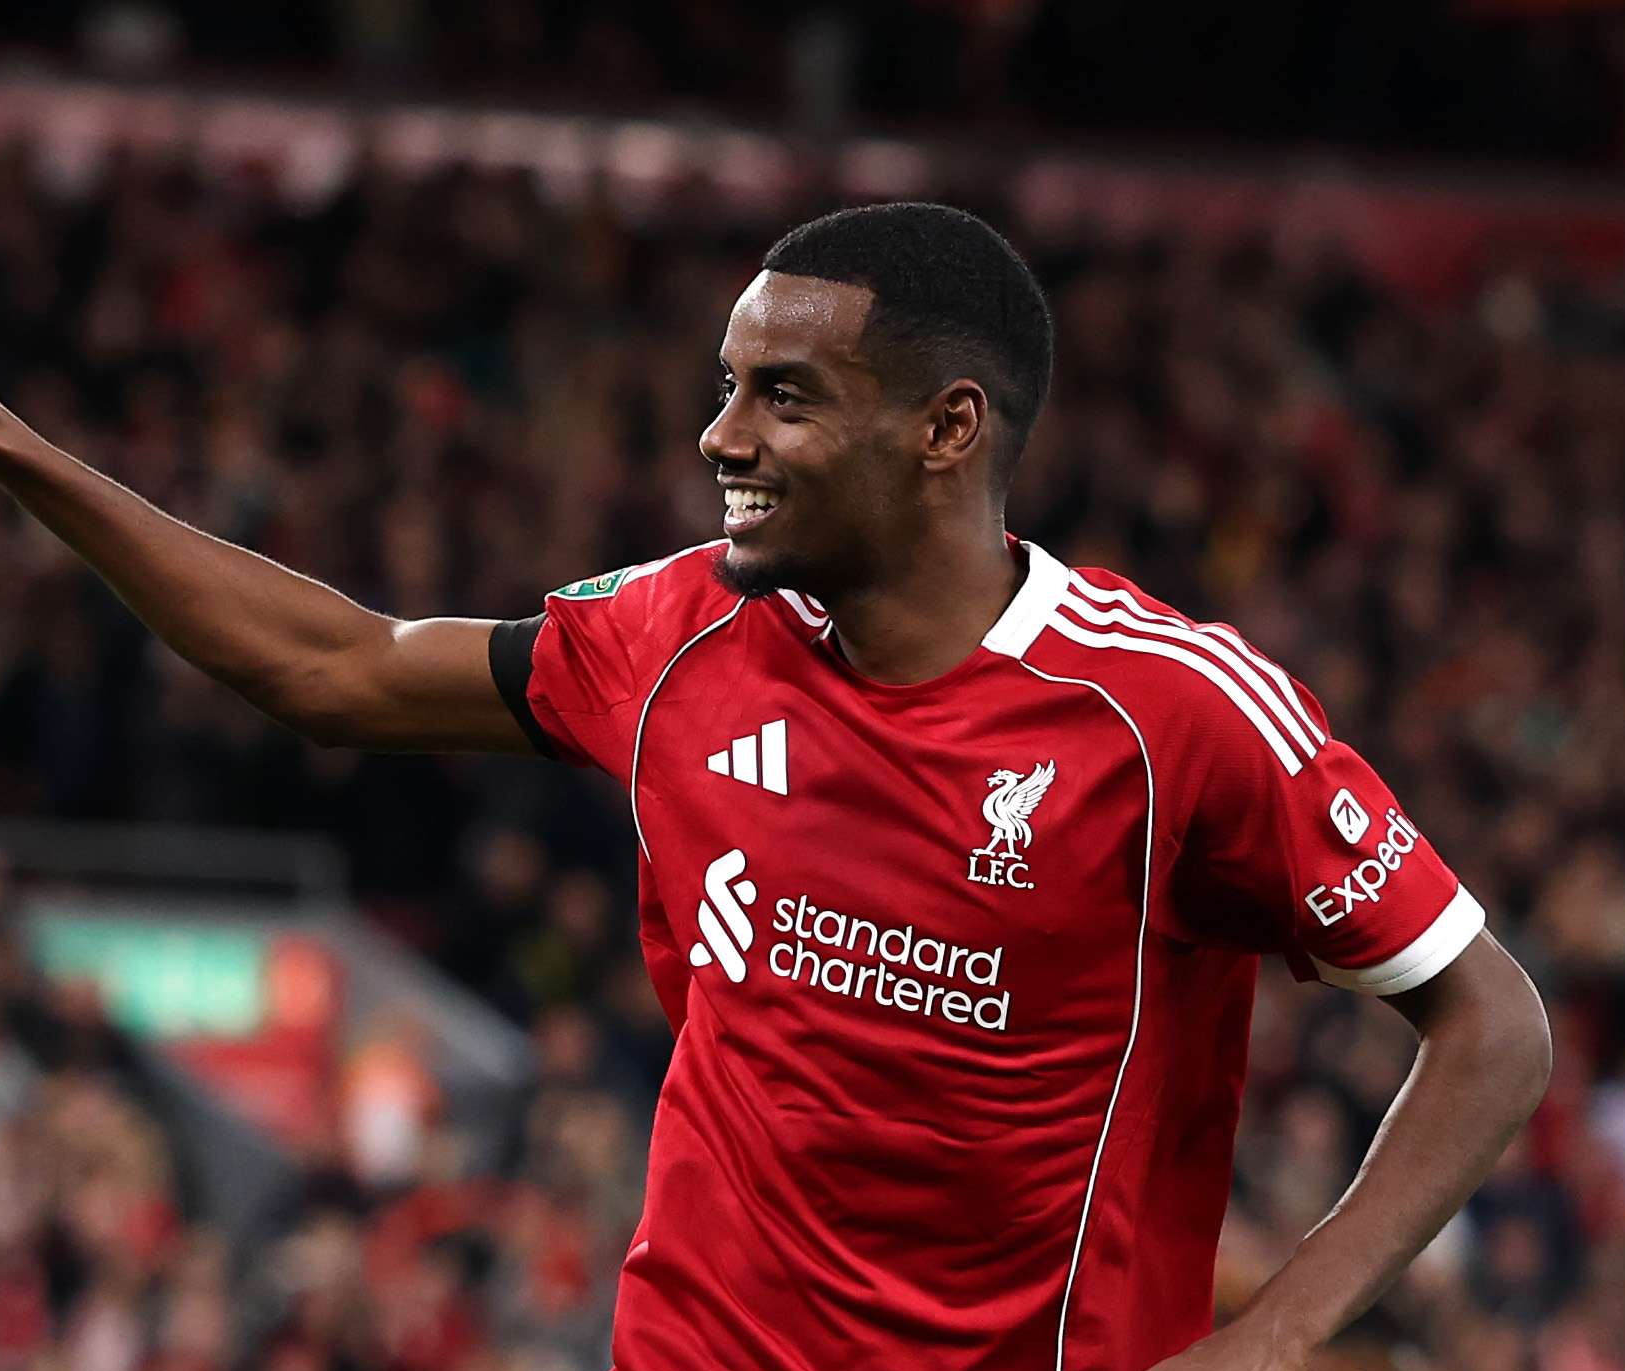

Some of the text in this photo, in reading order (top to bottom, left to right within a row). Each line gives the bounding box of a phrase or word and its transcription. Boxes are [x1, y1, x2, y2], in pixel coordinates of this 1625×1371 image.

[967, 856, 1035, 889] L.F.C.
[1305, 808, 1419, 926] Expedi
[769, 939, 1010, 1031] chartered
[772, 894, 1003, 986] standard
